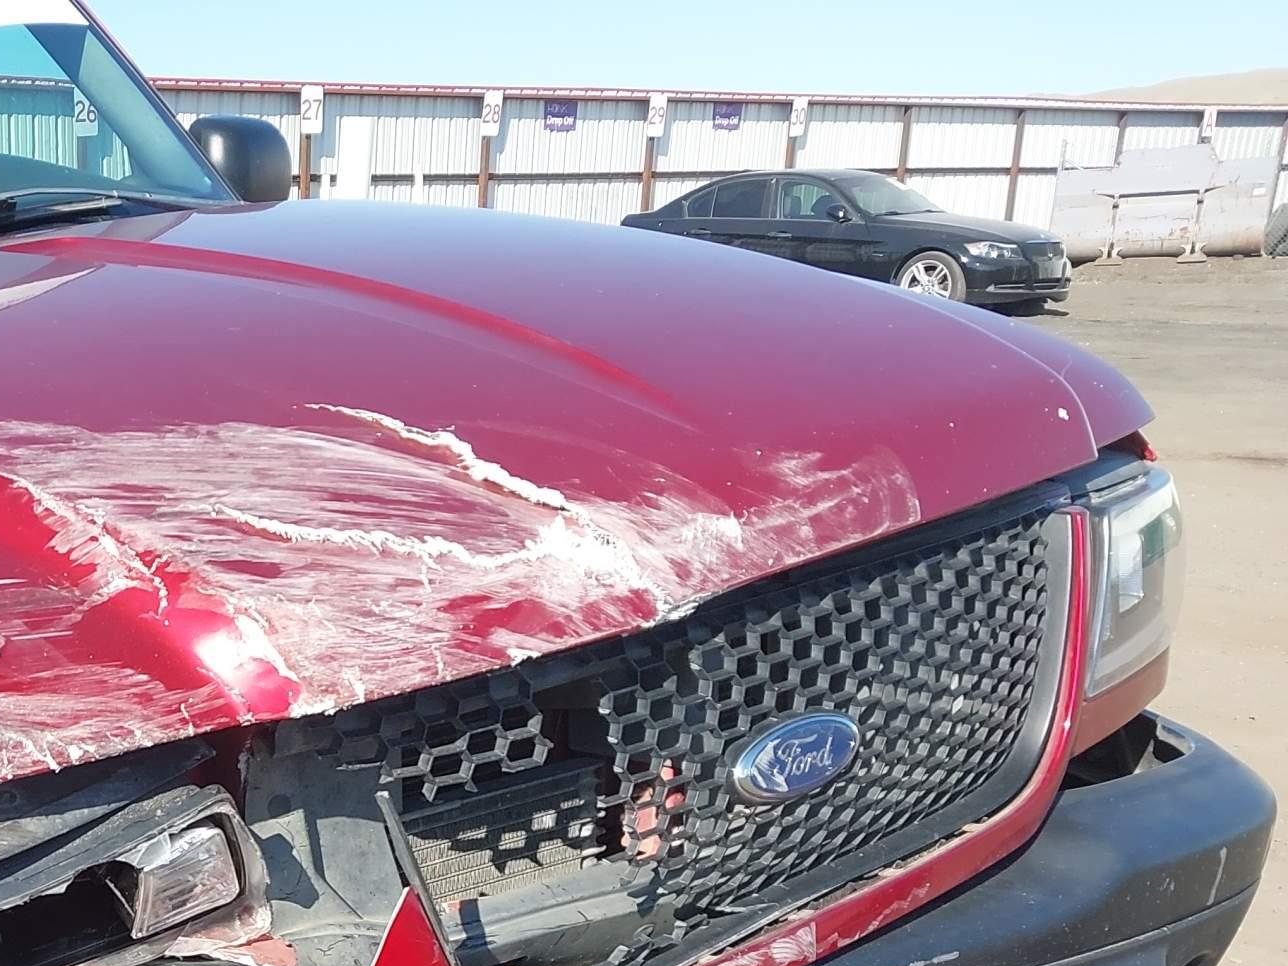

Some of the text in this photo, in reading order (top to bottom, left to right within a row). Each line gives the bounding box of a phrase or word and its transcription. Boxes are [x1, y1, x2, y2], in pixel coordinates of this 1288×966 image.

[75, 100, 97, 123] 26
[302, 98, 322, 121] 27
[482, 103, 501, 124] 28
[648, 106, 666, 125] 29
[791, 107, 807, 126] 30
[546, 115, 575, 127] Drop Off
[1204, 111, 1213, 133] A
[776, 733, 834, 779] Ford
